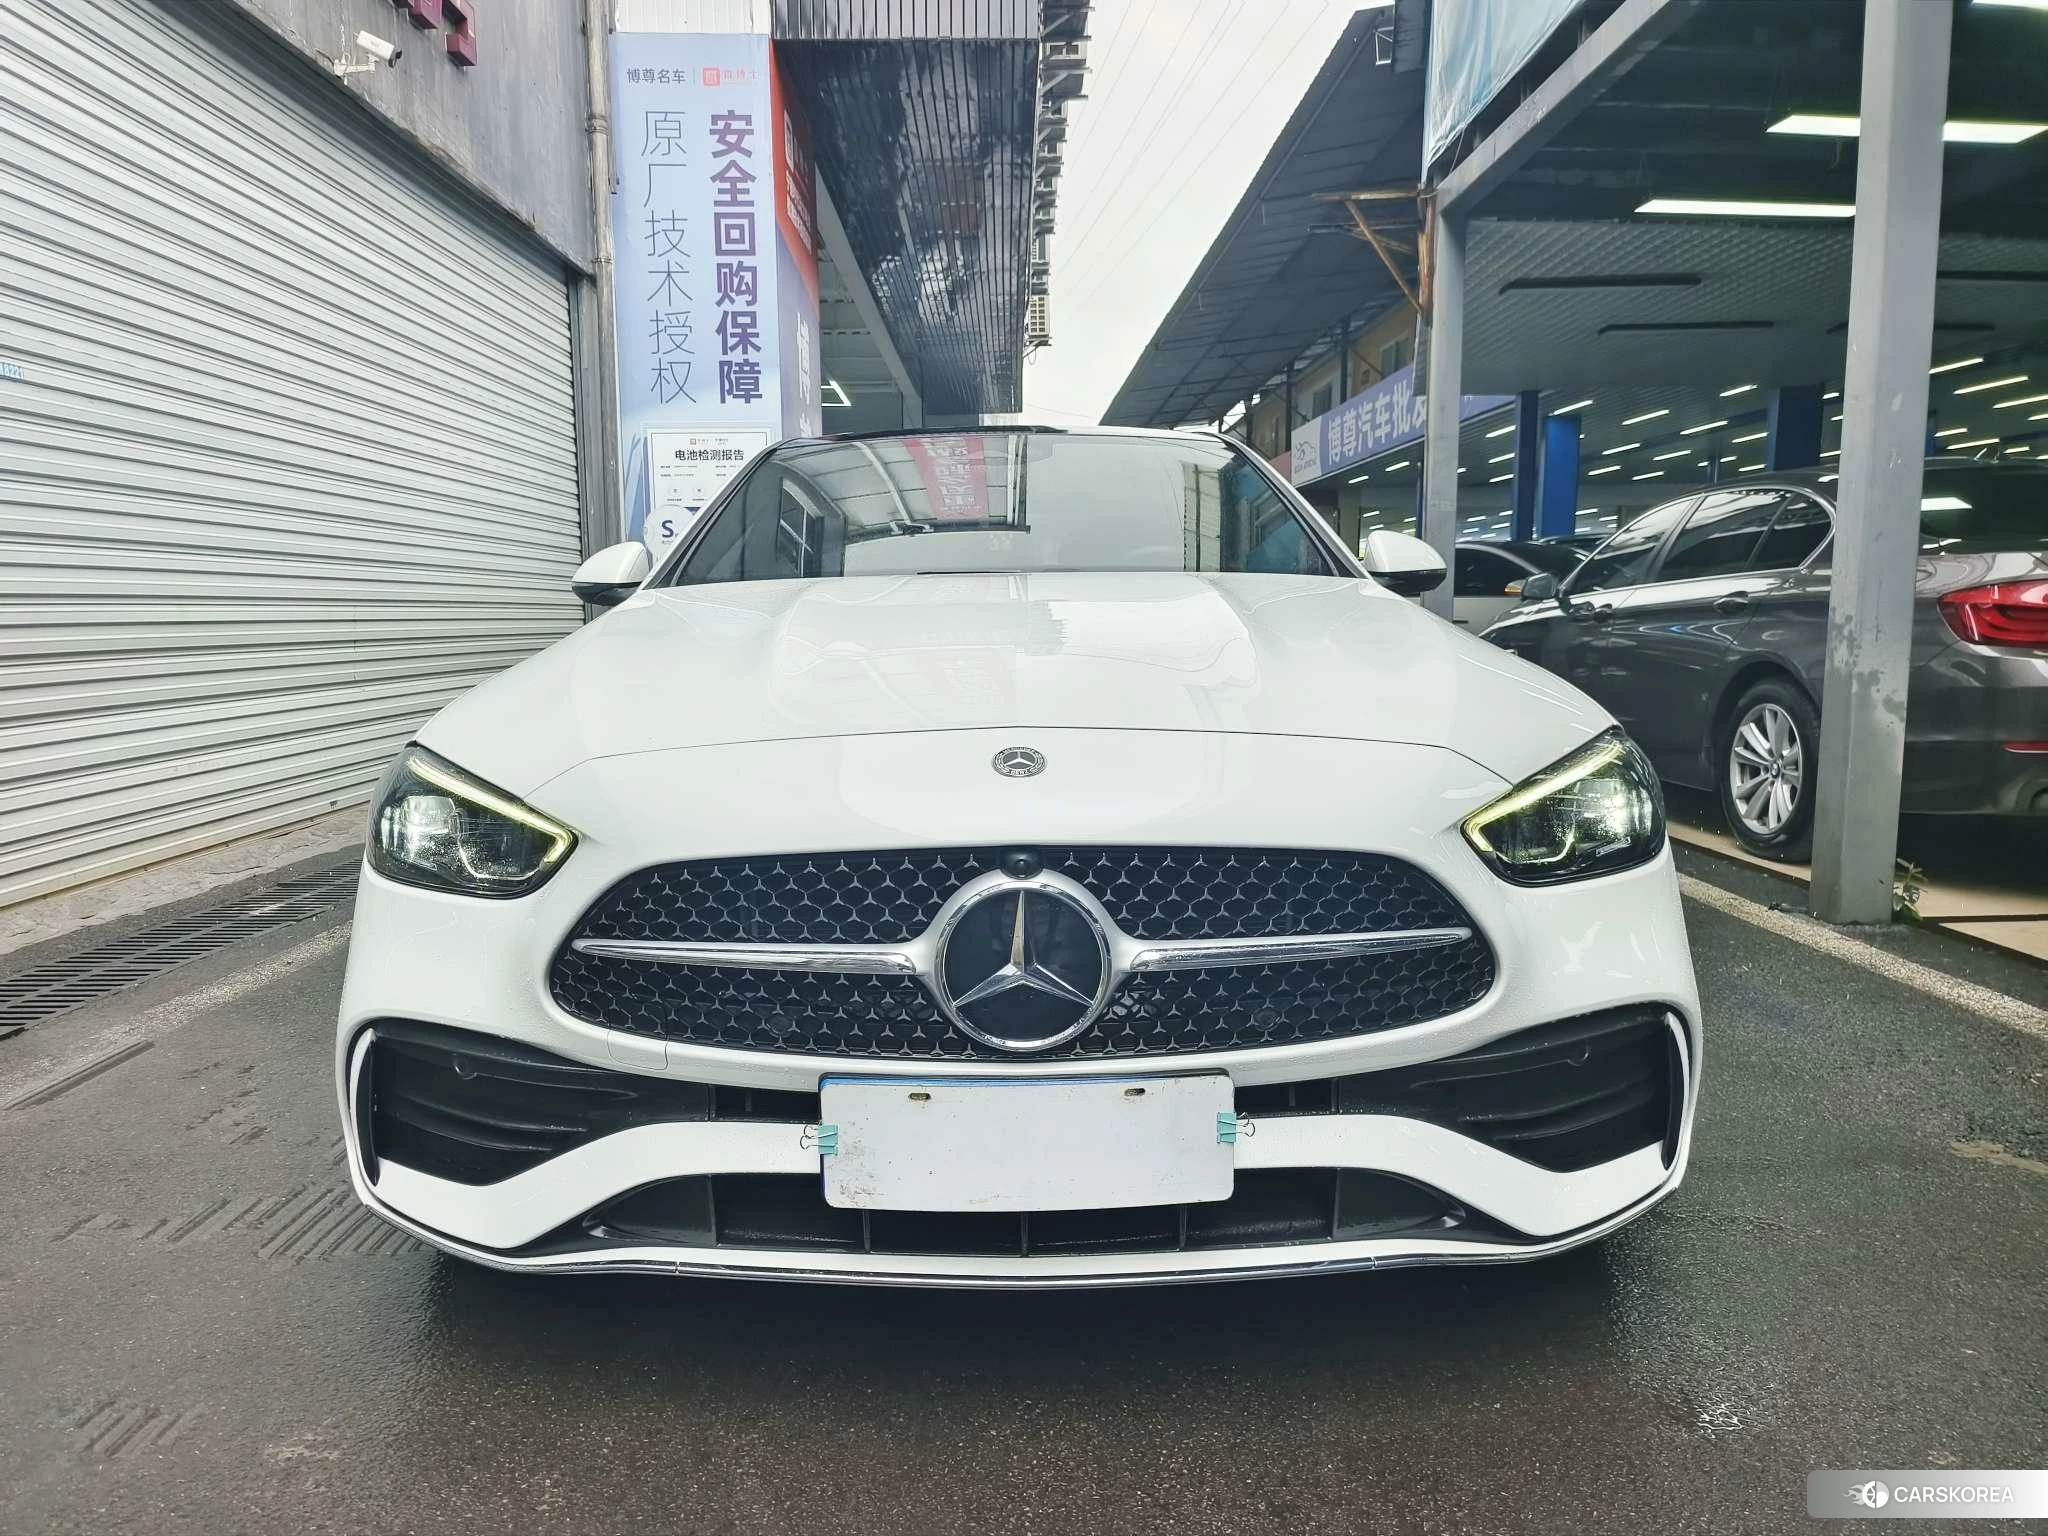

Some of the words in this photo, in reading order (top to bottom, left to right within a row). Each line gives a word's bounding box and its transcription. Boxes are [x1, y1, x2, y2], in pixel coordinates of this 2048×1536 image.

[626, 67, 687, 85] 博尊名车
[640, 110, 697, 405] 原厂技术授权
[709, 109, 763, 405] 安全回购保障
[675, 449, 744, 461] 电池检测报告
